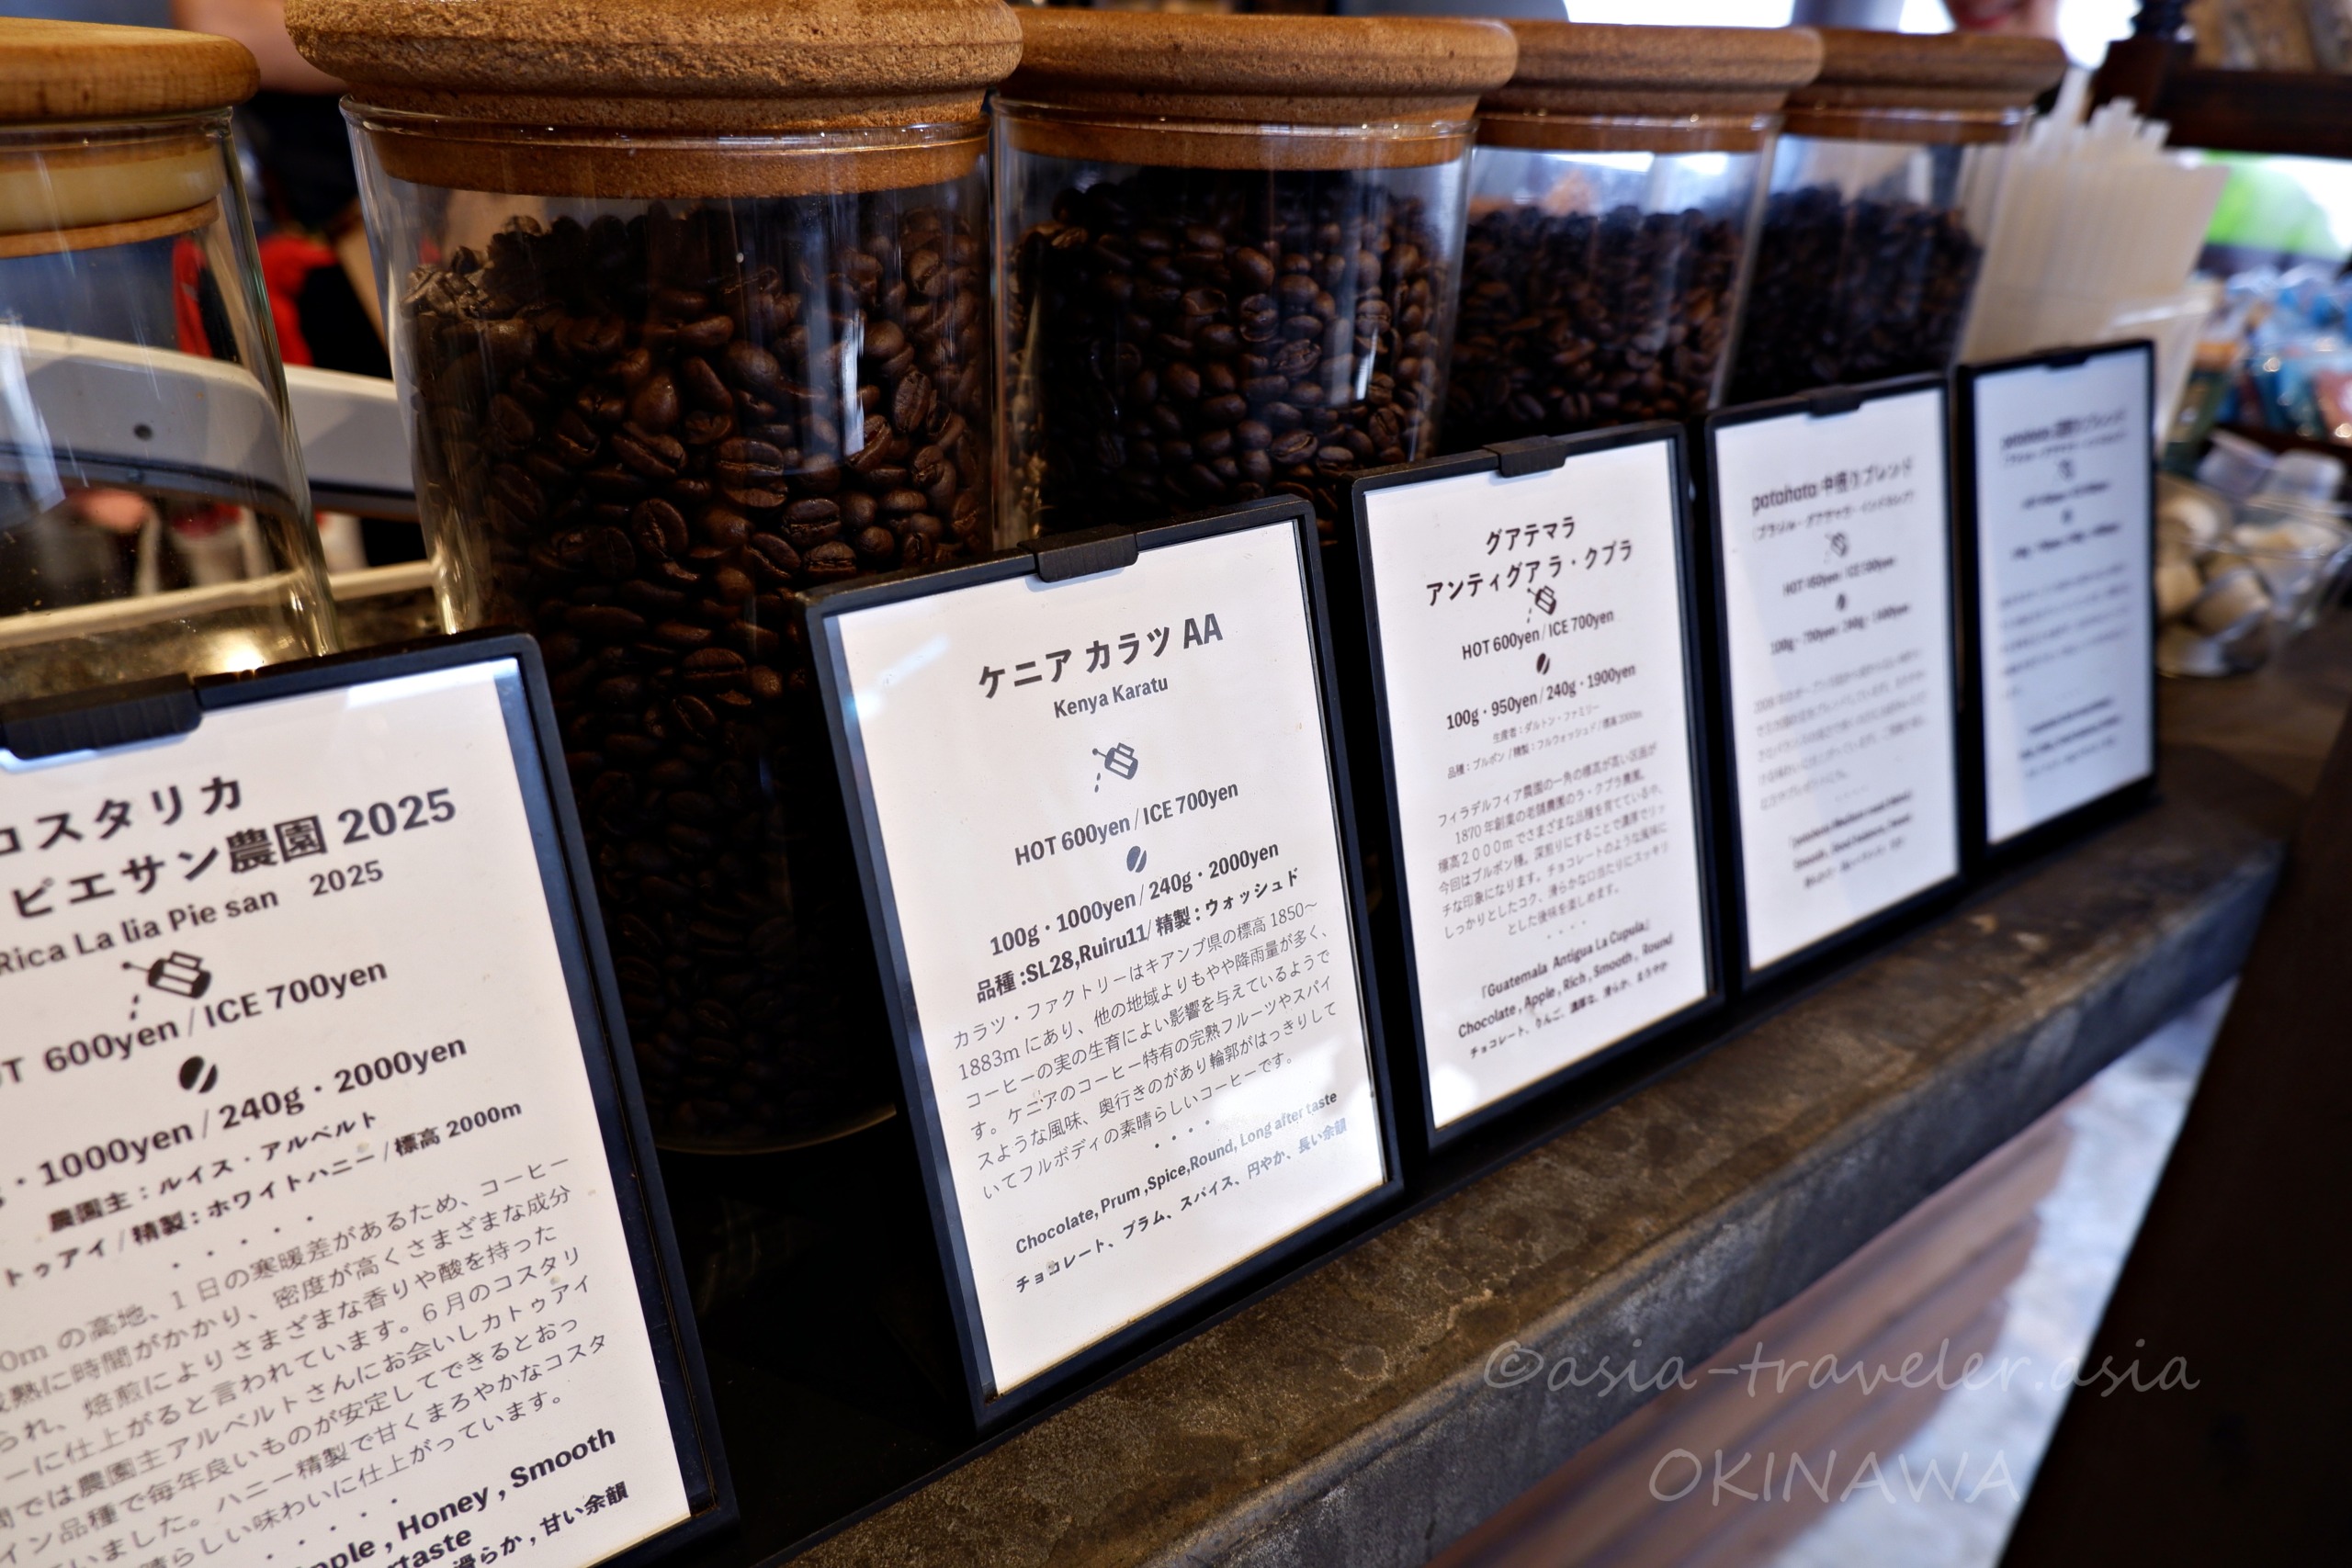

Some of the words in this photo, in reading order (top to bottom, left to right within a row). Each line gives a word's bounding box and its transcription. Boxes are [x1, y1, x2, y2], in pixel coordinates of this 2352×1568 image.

[1485, 514, 1576, 556] グアテマラ
[977, 647, 1073, 700] ケニア
[1084, 625, 1170, 674] カラツ
[1182, 611, 1224, 650] AA
[1461, 637, 1490, 660] HOT
[1491, 628, 1541, 652] 600yen
[1547, 618, 1569, 638] ICE
[1569, 609, 1614, 632] 700yen
[1052, 692, 1110, 719] Kenya
[1110, 676, 1169, 704] Karatu
[336, 786, 456, 845] 2025
[1013, 834, 1057, 867] HOT
[1059, 816, 1131, 852] 600yen
[1141, 798, 1174, 826] ICE
[1173, 782, 1239, 815] 700yen
[72, 931, 115, 956] La
[166, 903, 217, 932] Pie
[223, 889, 279, 919] san
[308, 858, 384, 897] 2025
[1551, 942, 1594, 970] Antigua
[1594, 936, 1609, 951] La
[42, 1020, 180, 1073] 600yen
[202, 991, 262, 1028] ICE
[265, 962, 388, 1010] 700yen
[1238, 1120, 1273, 1148] Long
[1272, 1106, 1304, 1131] after
[1305, 1091, 1338, 1114] taste
[509, 1427, 616, 1489] Smooth
